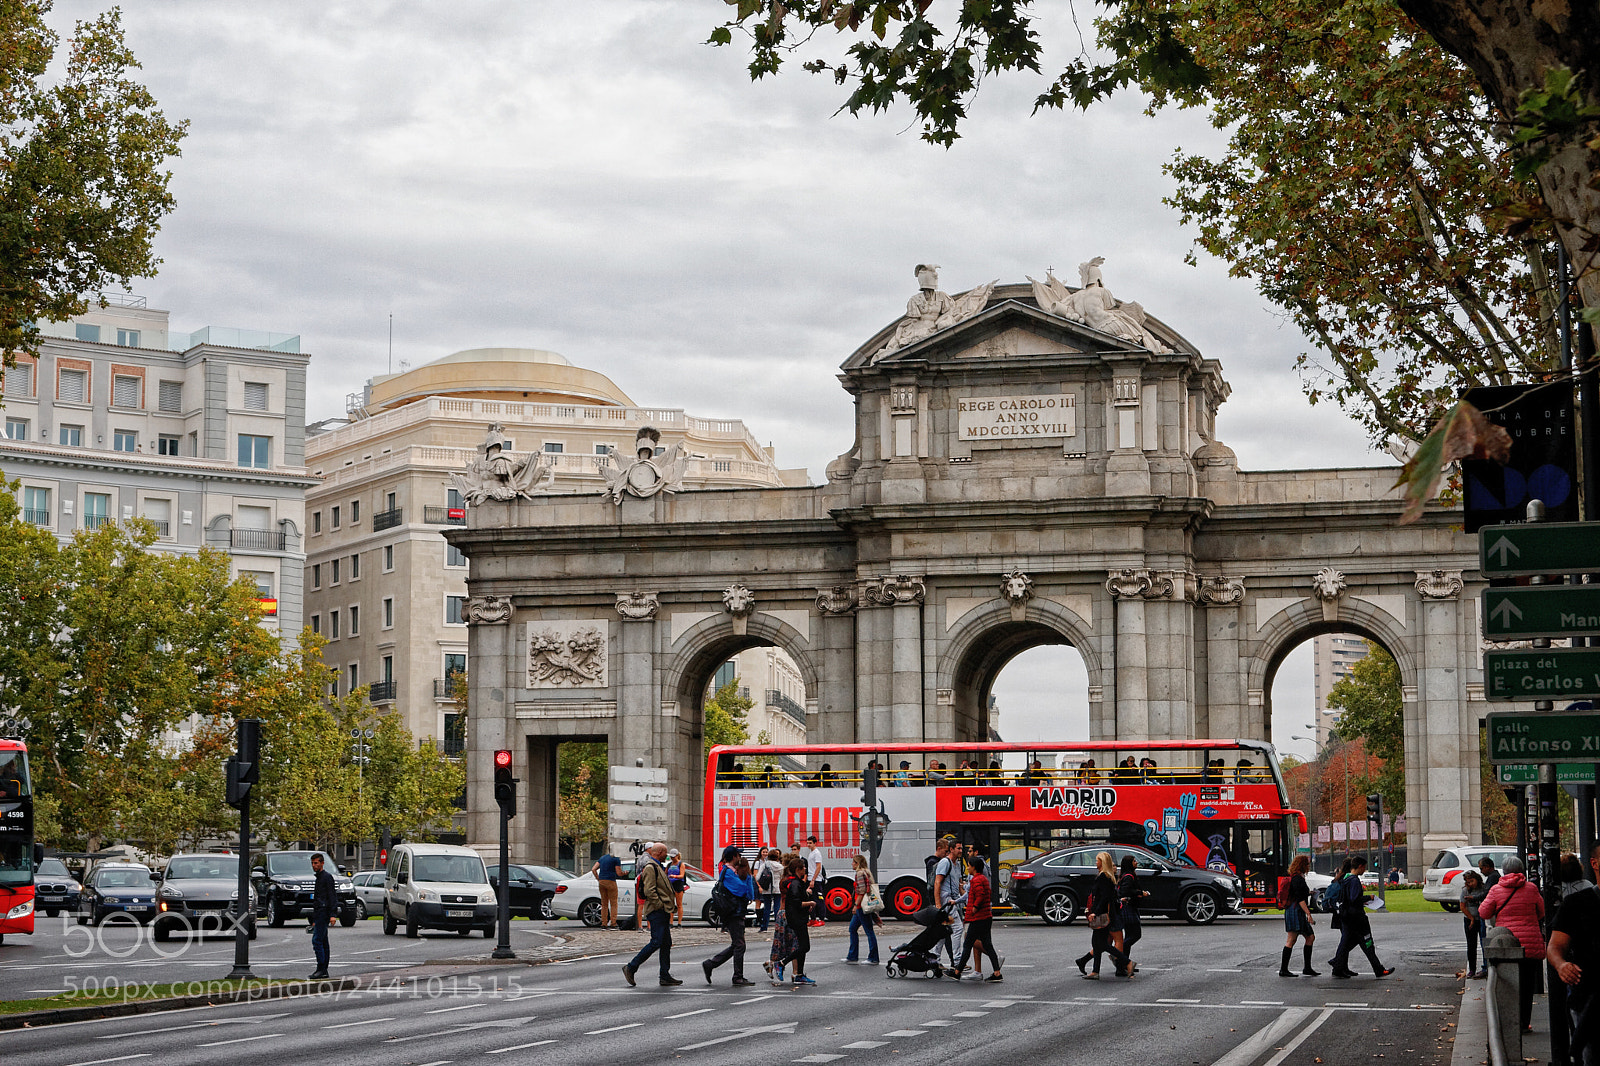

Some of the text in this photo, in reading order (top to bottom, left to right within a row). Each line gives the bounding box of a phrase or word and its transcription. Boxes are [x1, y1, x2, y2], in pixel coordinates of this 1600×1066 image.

[959, 398, 1075, 412] REGE CAROLO III
[996, 412, 1038, 423] ANNO
[1544, 409, 1566, 418] DE
[967, 424, 1067, 436] MDCCLXXVIII
[1494, 658, 1558, 671] plaza del
[1521, 675, 1584, 689] Carlos
[1496, 722, 1530, 733] calle
[1497, 737, 1572, 752] Alfonso
[1031, 788, 1117, 809] MADRID
[7, 811, 24, 819] 4598
[1060, 802, 1114, 819] City Tour
[719, 807, 863, 849] BILLY ELLIOT
[828, 848, 834, 859] EL
